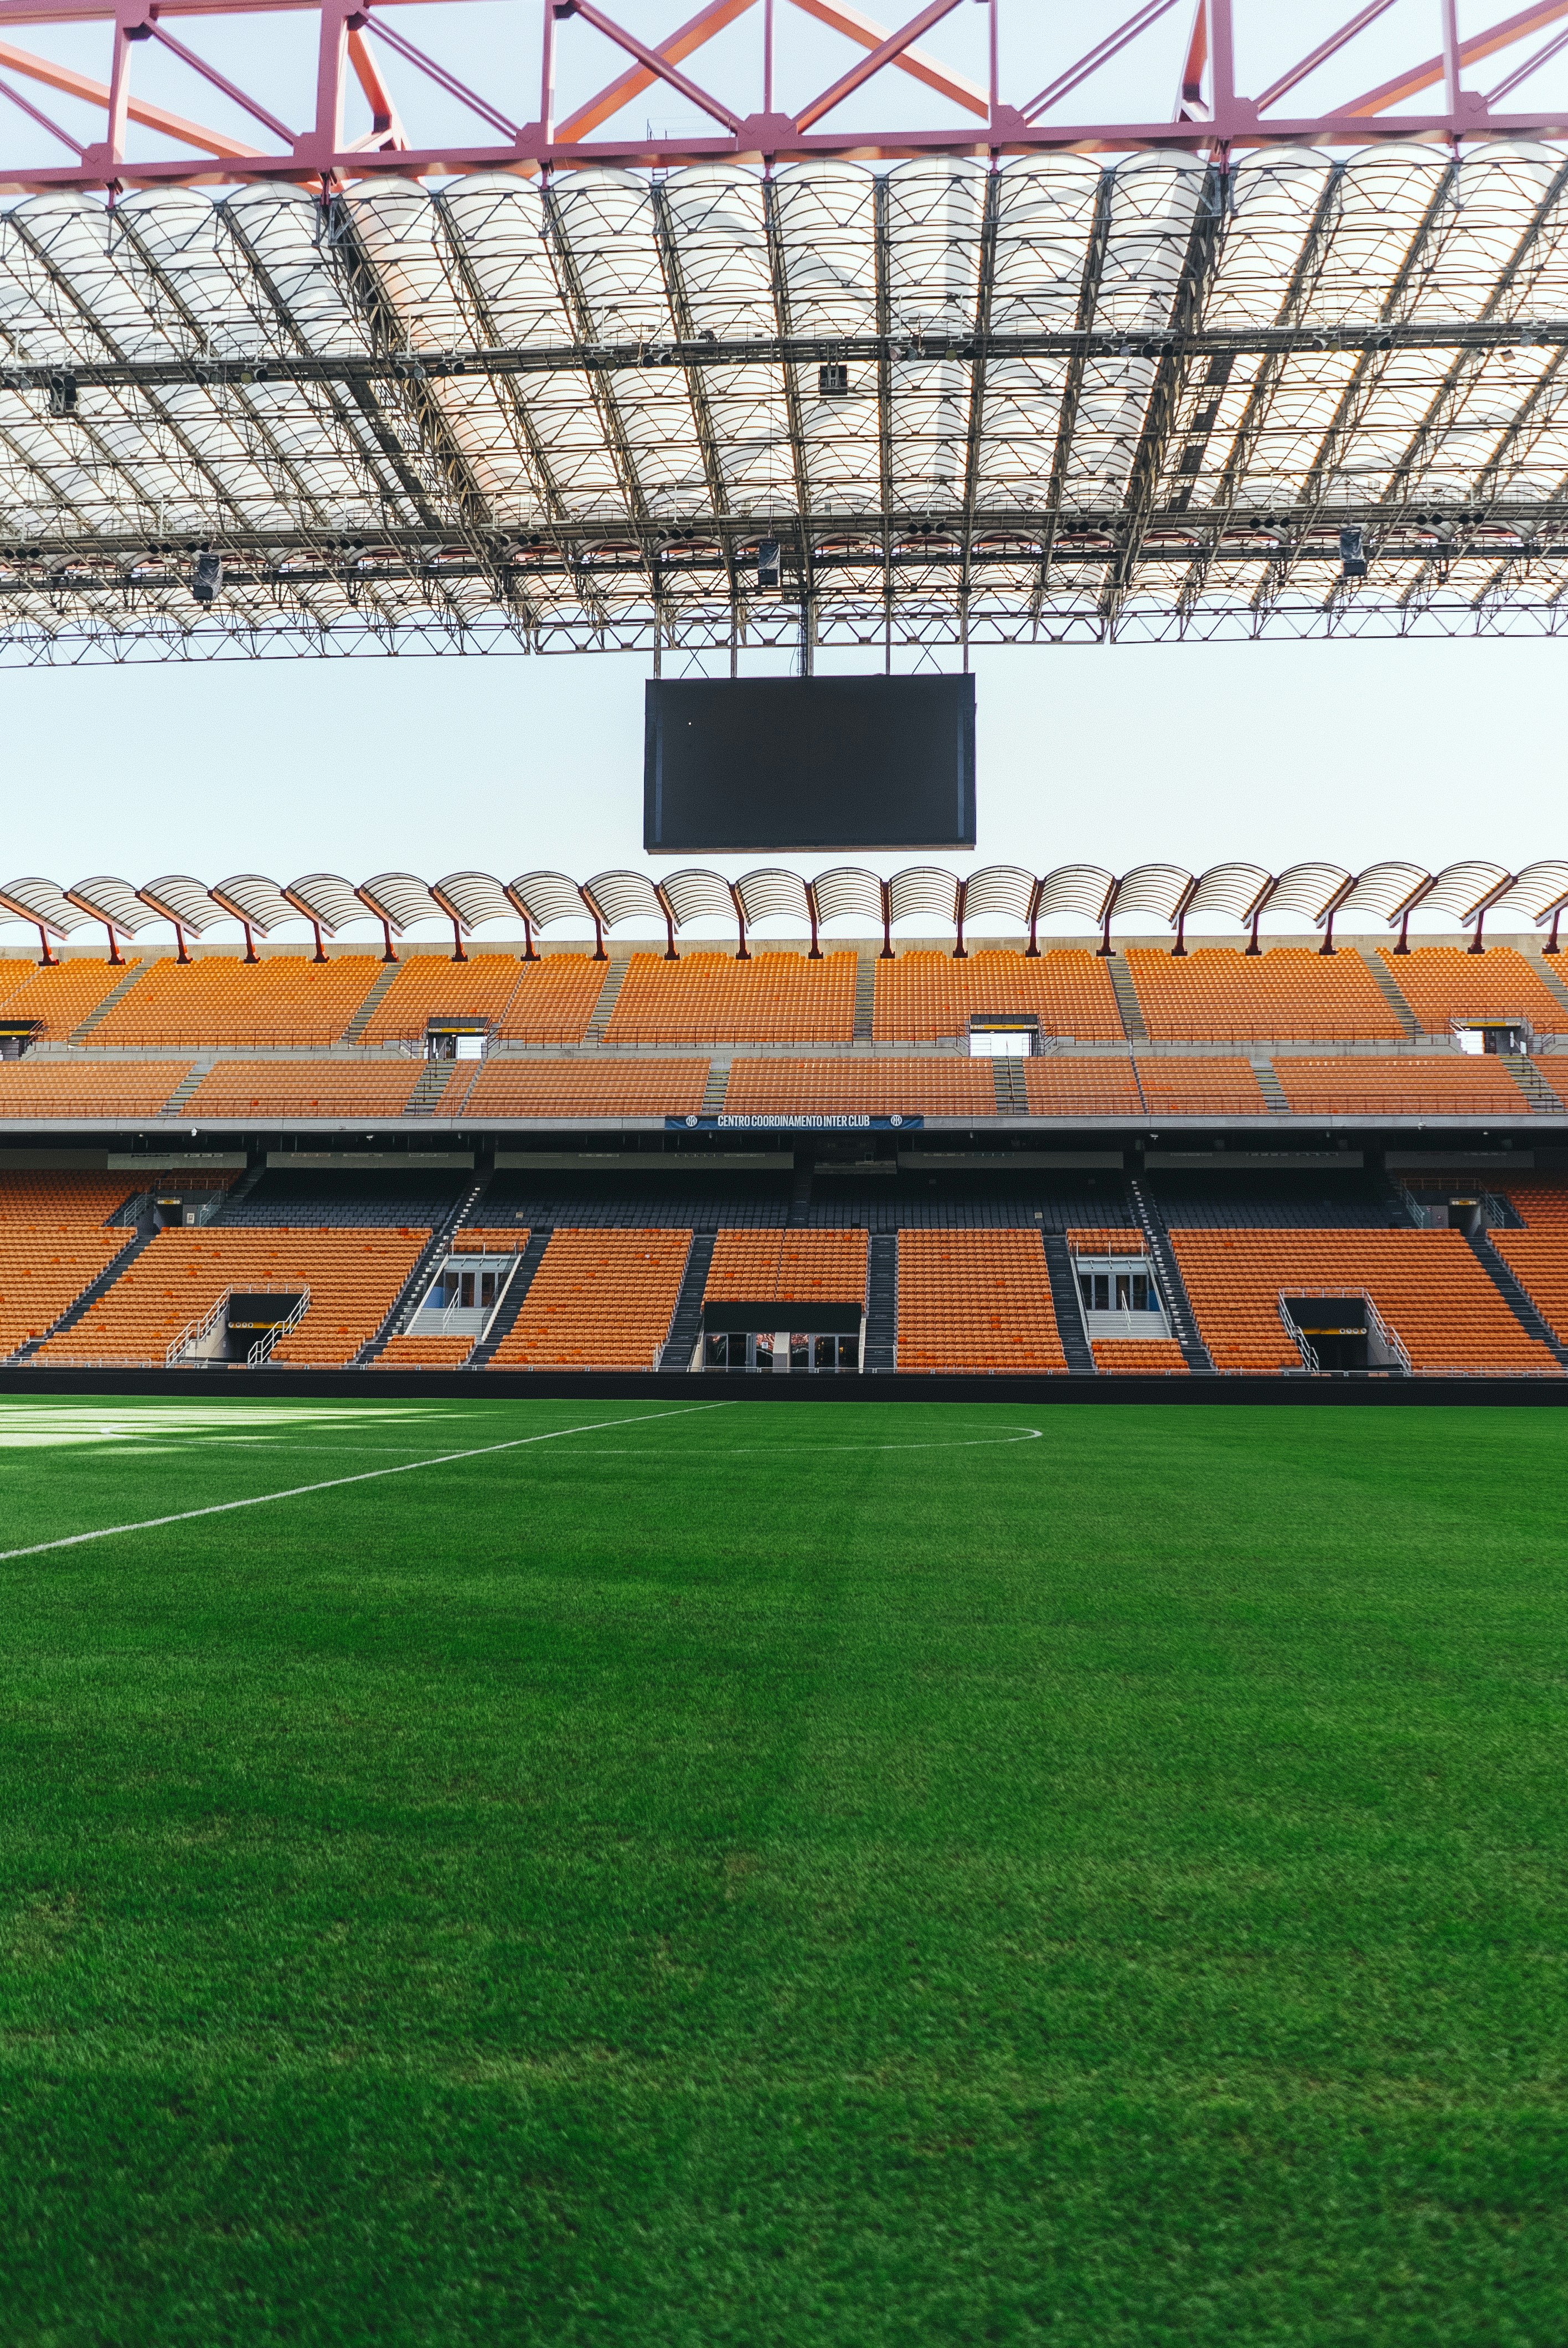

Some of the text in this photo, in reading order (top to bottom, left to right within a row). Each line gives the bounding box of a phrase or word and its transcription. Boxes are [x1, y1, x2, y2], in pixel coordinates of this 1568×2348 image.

[718, 1115, 870, 1127] CENTRO COORDINAMENTO INTER CLUB
